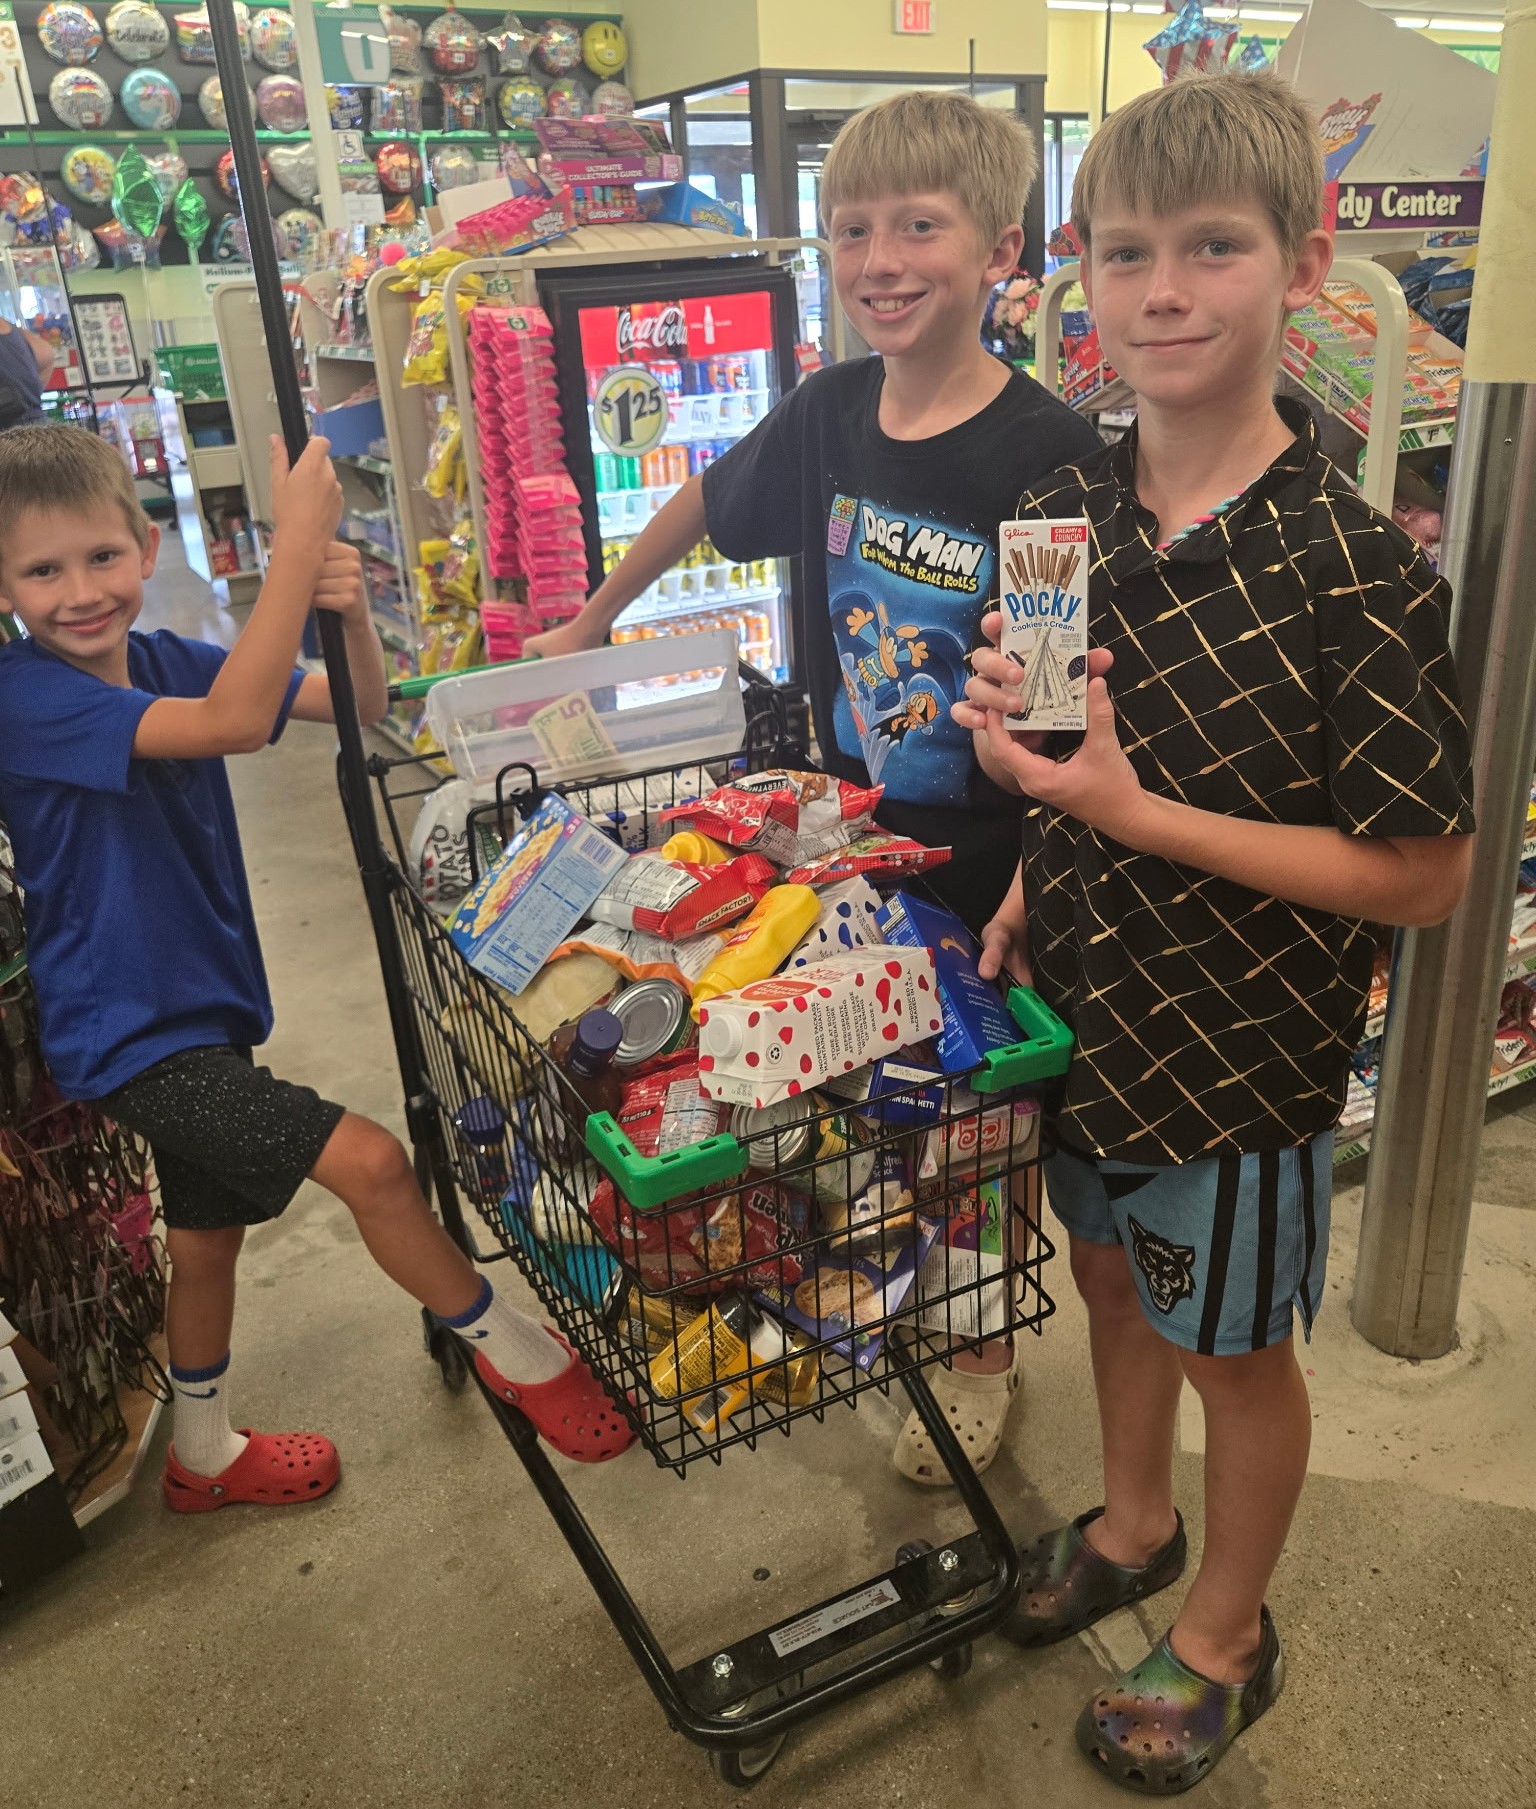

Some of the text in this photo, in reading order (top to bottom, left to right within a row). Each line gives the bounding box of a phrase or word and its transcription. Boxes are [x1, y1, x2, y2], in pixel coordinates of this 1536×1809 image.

[1381, 186, 1462, 218] Center
[863, 506, 984, 576] DOG MAN
[1004, 528, 1034, 541] Glico
[1055, 533, 1083, 543] CRUNCHY
[1011, 621, 1043, 633] Cookies
[1049, 620, 1075, 632] Cream
[735, 780, 787, 793] EVERYTHING
[493, 817, 542, 871] SEET
[698, 896, 751, 926] SNACK FACTORY
[906, 987, 914, 1024] PRODUCED
[831, 1007, 840, 1056] TEMPERATURE
[849, 992, 862, 1055] SUGGESTED USAGE
[1497, 1038, 1525, 1055] Trident
[902, 1096, 935, 1110] SPAHETTI
